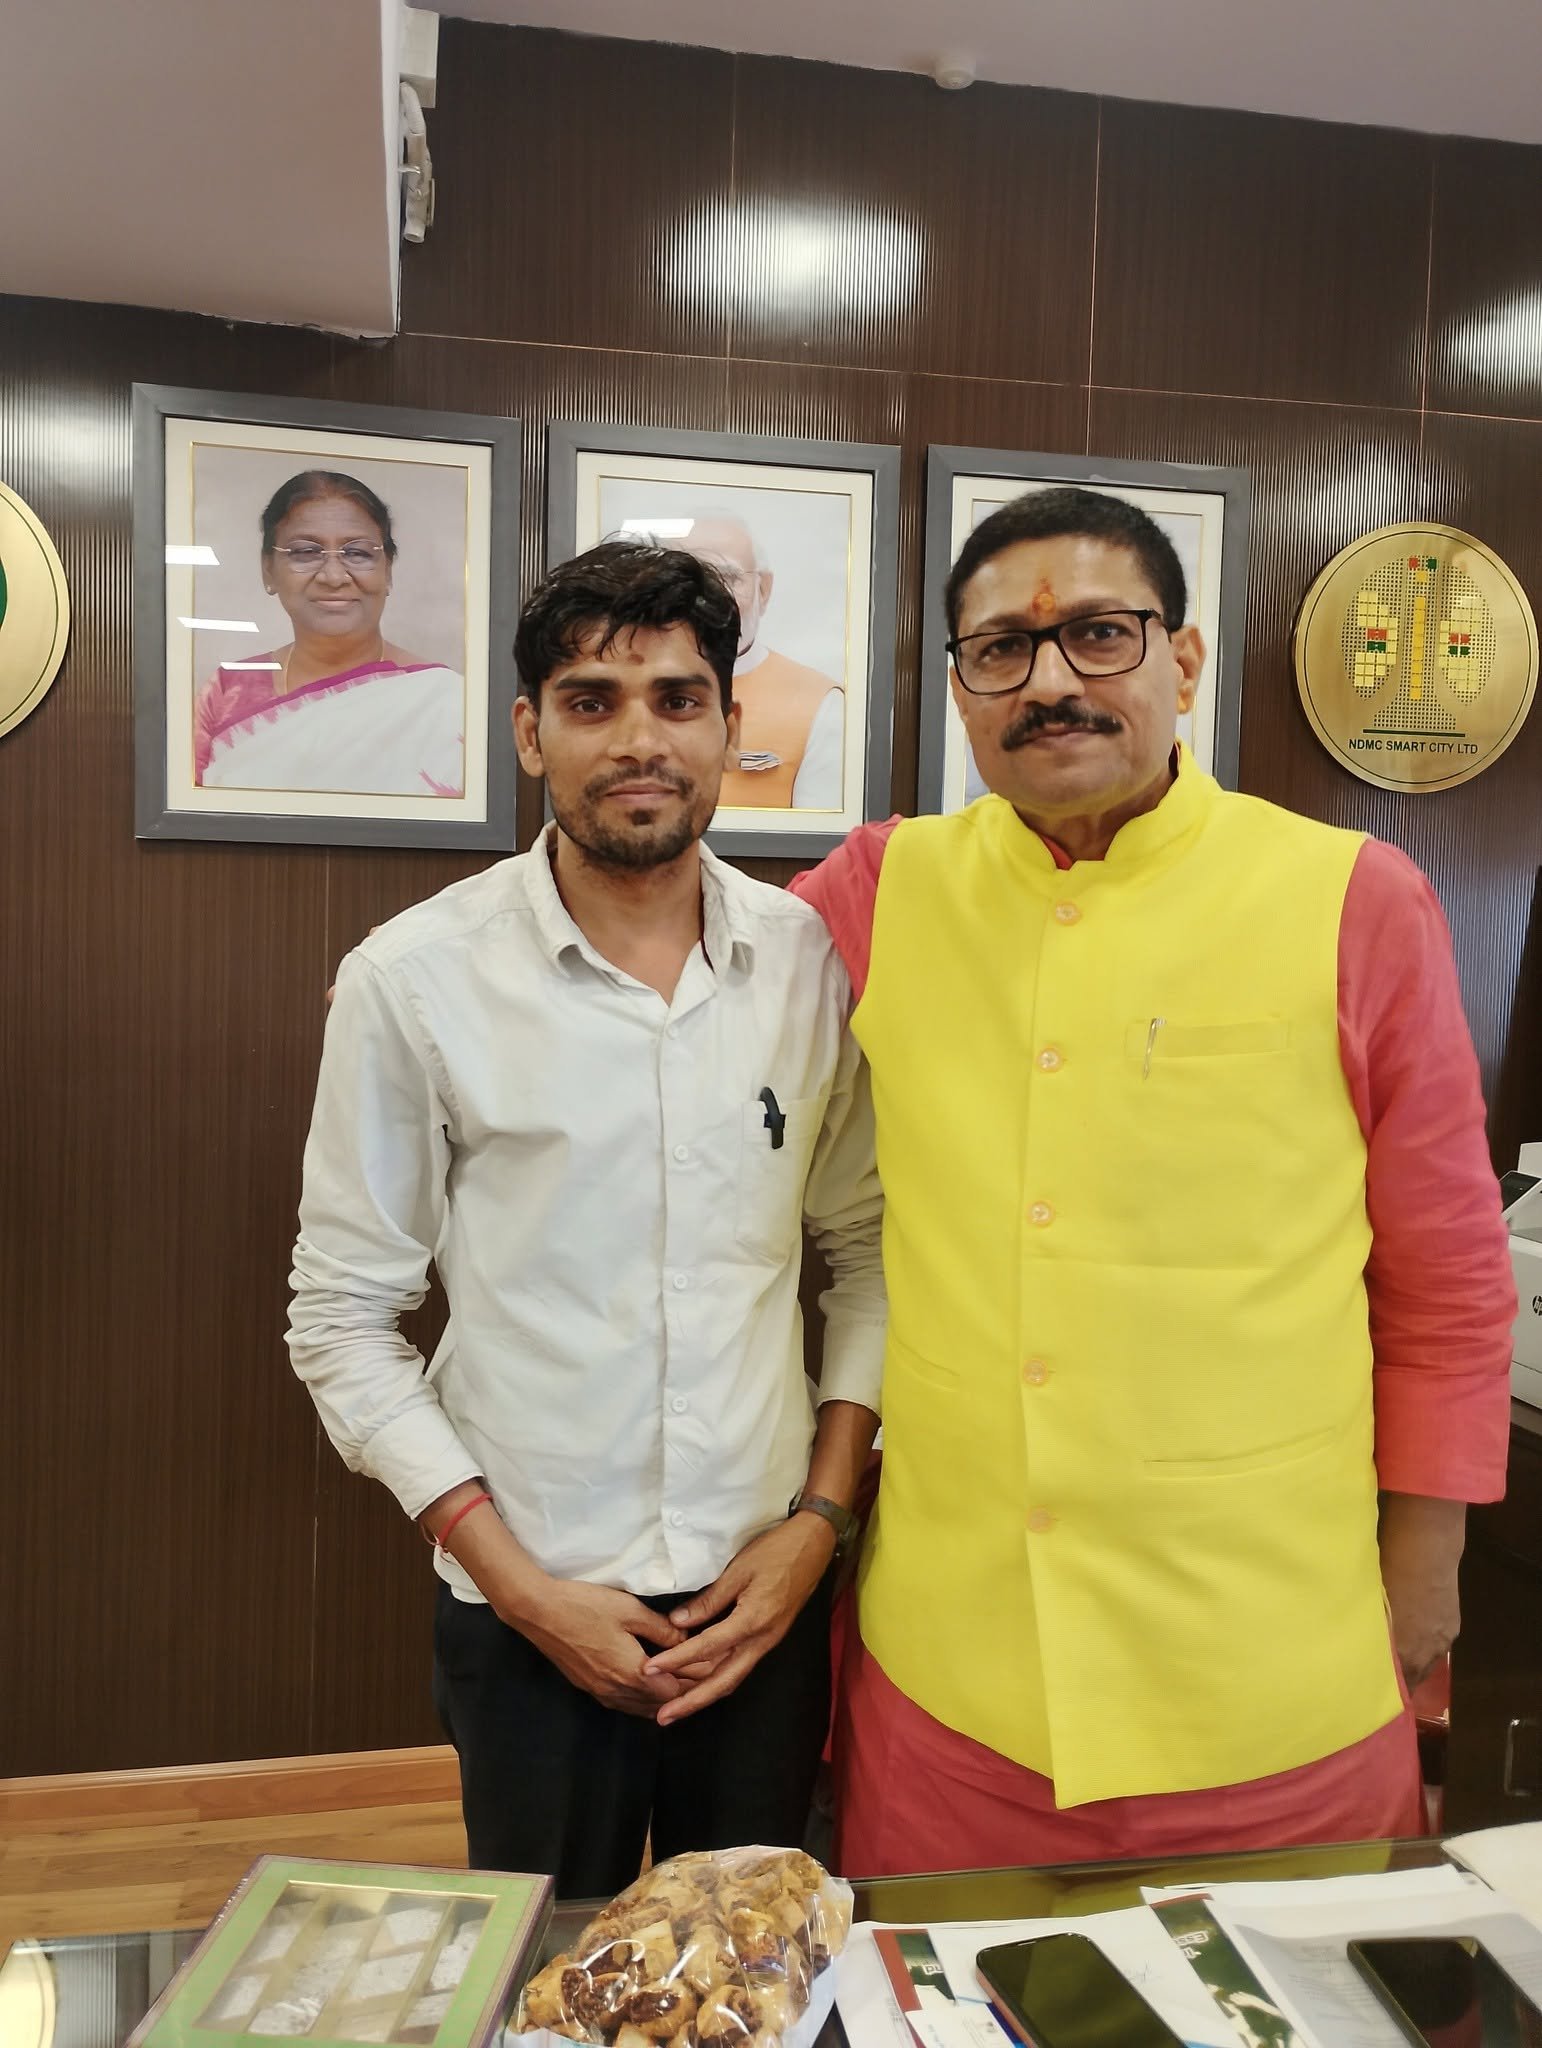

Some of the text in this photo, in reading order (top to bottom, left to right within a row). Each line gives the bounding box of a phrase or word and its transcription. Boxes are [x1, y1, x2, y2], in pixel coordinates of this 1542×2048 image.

[1348, 738, 1478, 754] NDMC SMART CITY LTD
